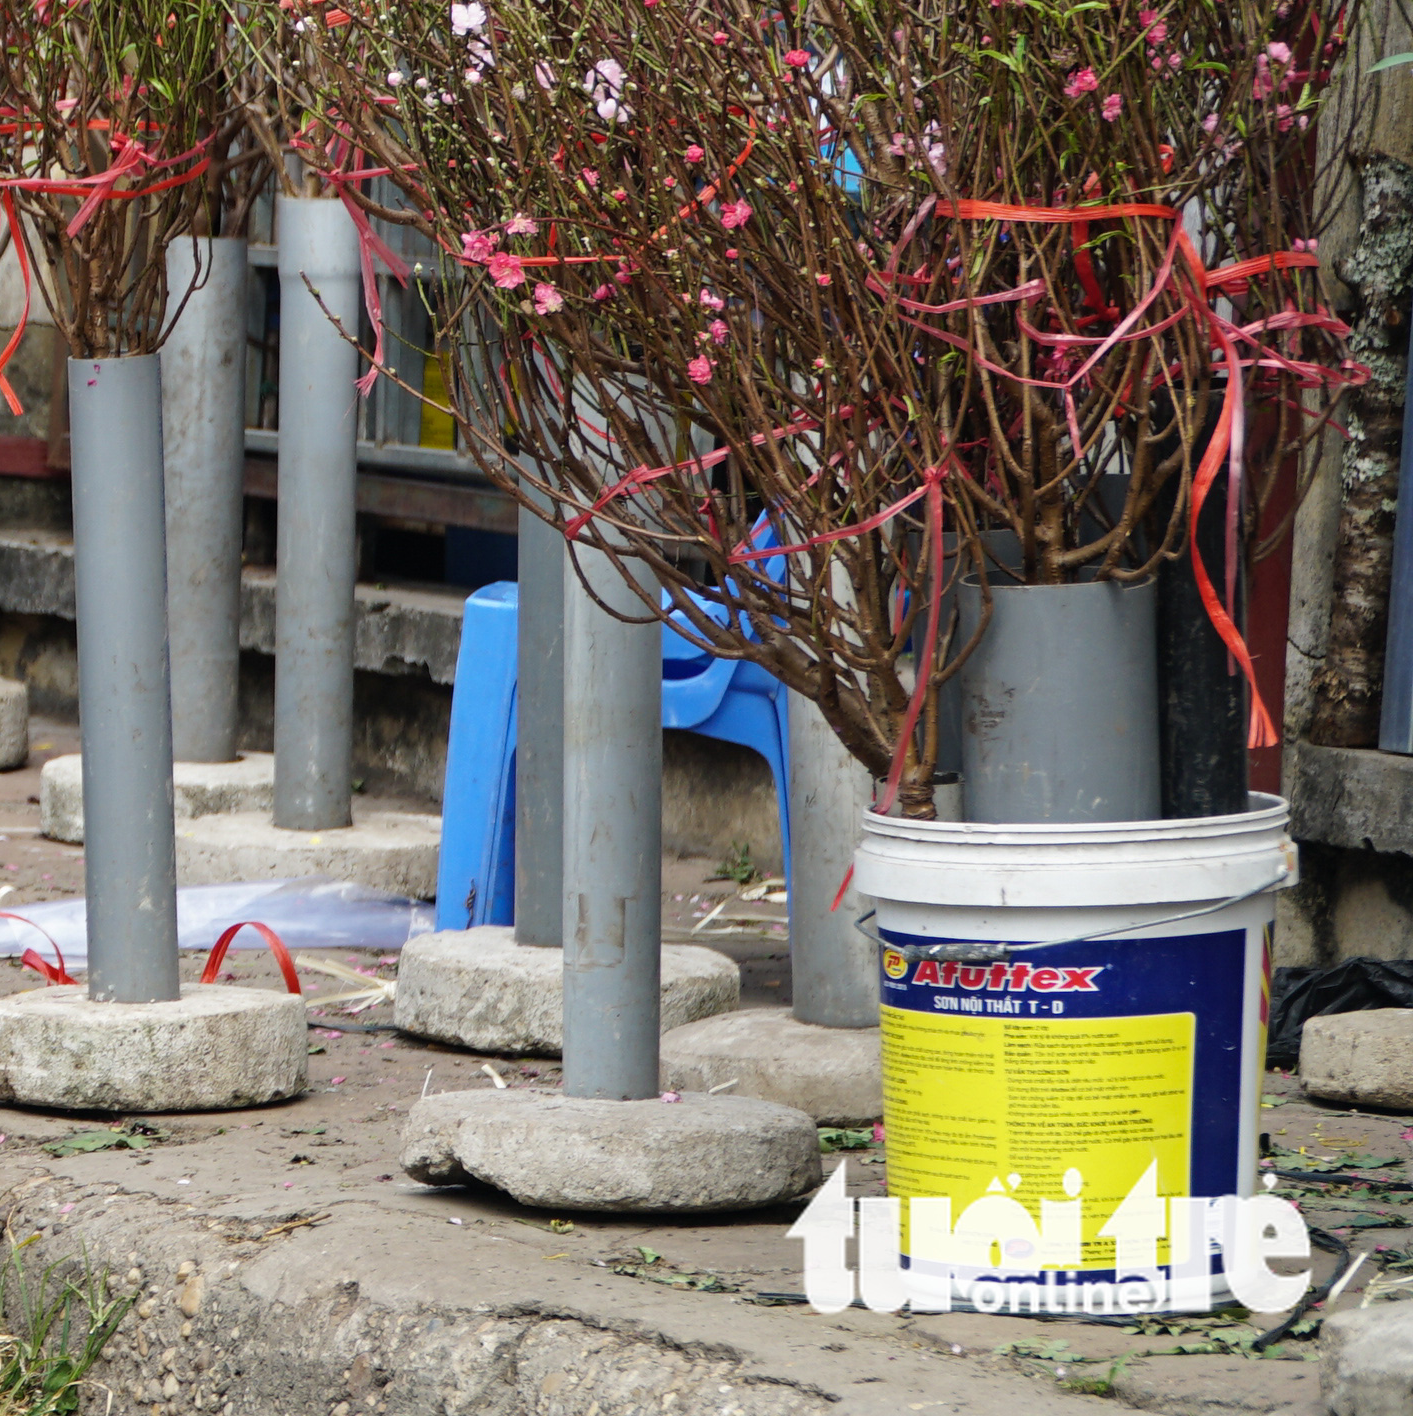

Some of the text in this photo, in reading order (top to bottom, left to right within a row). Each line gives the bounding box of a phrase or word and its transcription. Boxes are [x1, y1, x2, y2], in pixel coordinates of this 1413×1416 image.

[912, 961, 1105, 993] Afuttex
[934, 995, 959, 1011] SƠN
[961, 996, 983, 1015] NỘI
[986, 994, 1023, 1014] THẤT
[1028, 1000, 1039, 1014] T
[1052, 1000, 1064, 1014] D
